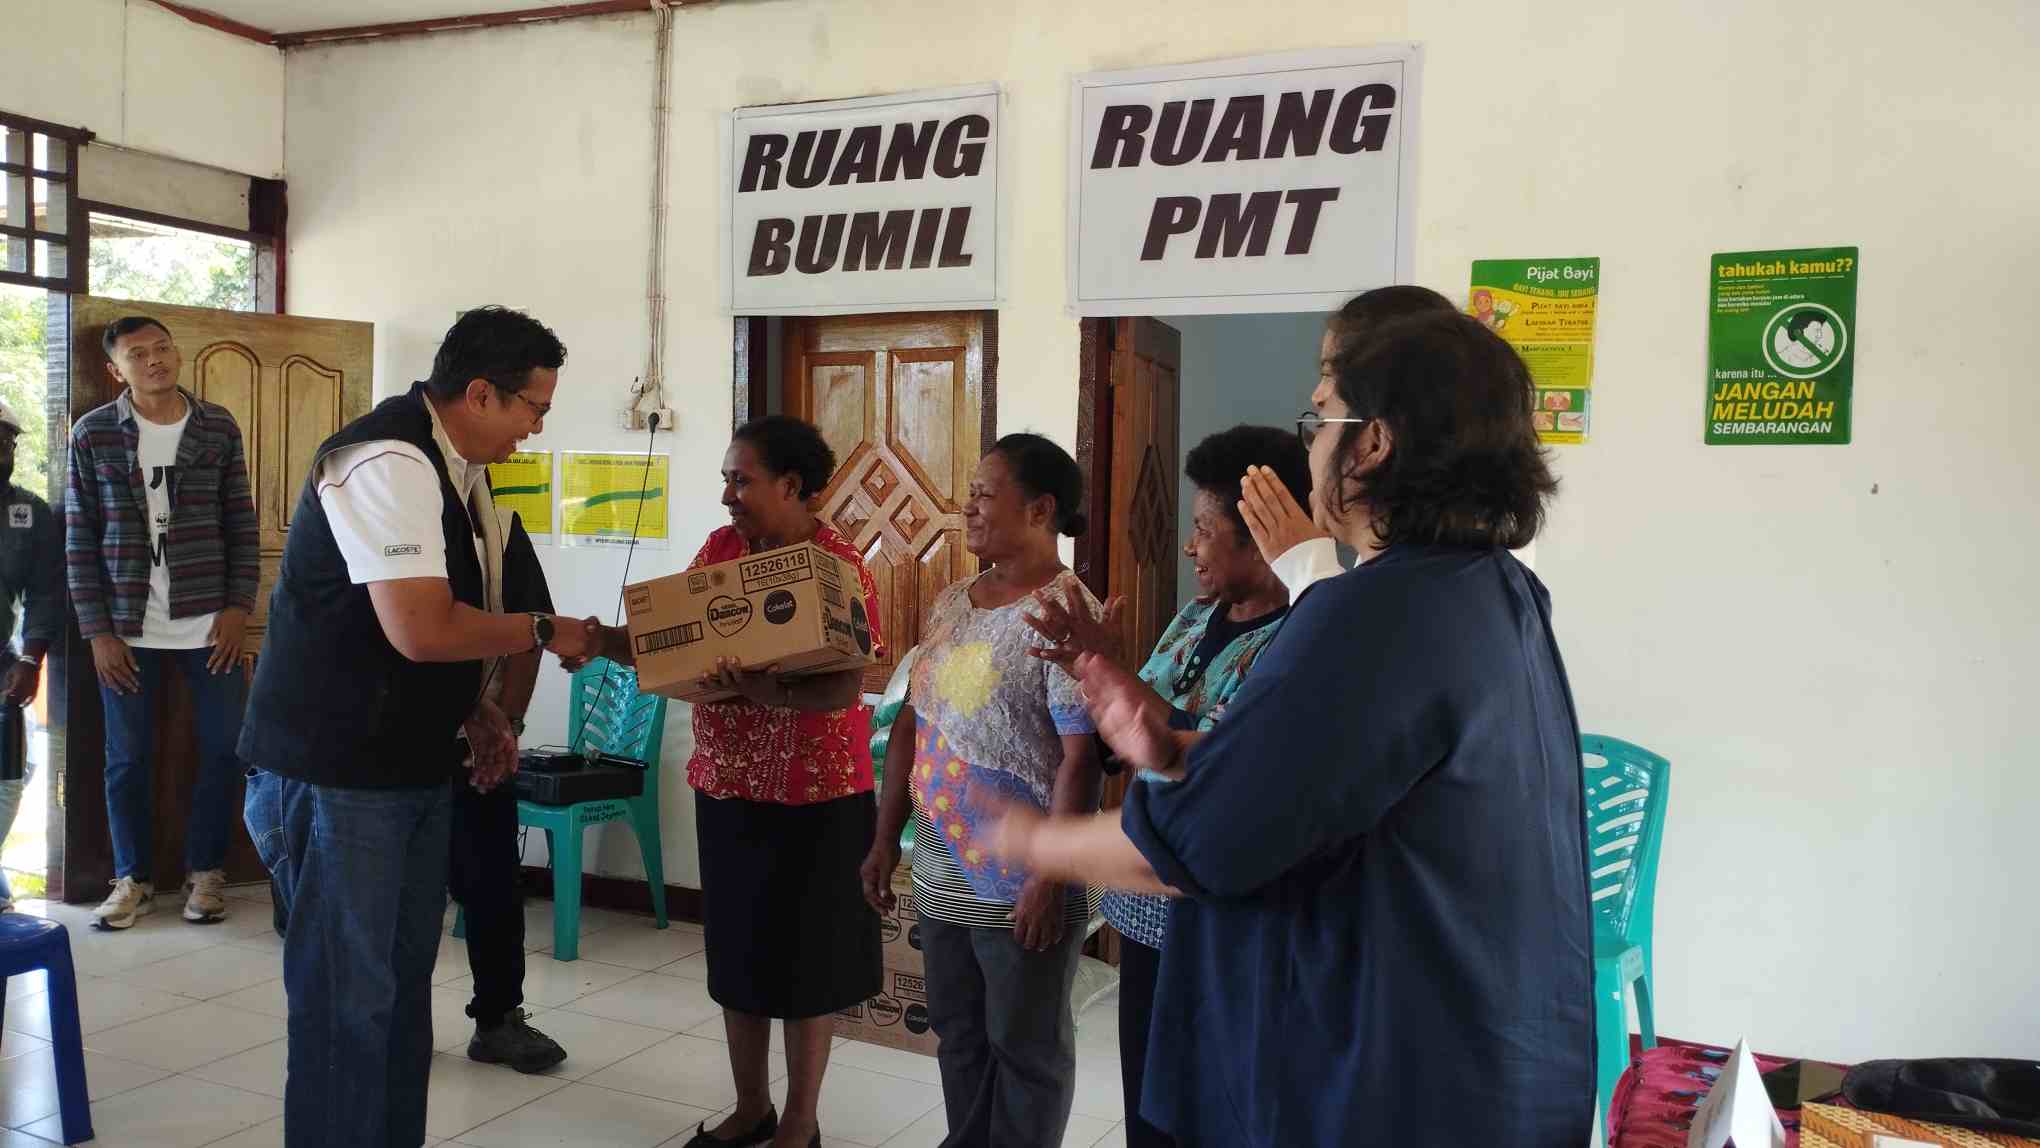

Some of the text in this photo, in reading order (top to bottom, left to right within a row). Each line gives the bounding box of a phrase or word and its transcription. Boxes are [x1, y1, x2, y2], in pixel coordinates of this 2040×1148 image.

[1090, 83, 1397, 169] RUANG
[737, 114, 990, 193] RUANG
[1140, 187, 1340, 261] PMT
[746, 206, 973, 277] BUMIL
[1527, 265, 1594, 283] Pijat Bayi
[1719, 258, 1853, 277] tahukah kamu??
[1715, 369, 1748, 379] karena
[1751, 368, 1765, 379] itu
[1714, 381, 1816, 401] JANGAN
[1712, 401, 1834, 421] MELUDAH
[1713, 422, 1832, 435] SEMBARANGAN
[387, 546, 418, 554] LACOSTE
[744, 553, 806, 577] 12526118
[897, 977, 927, 990] 12526
